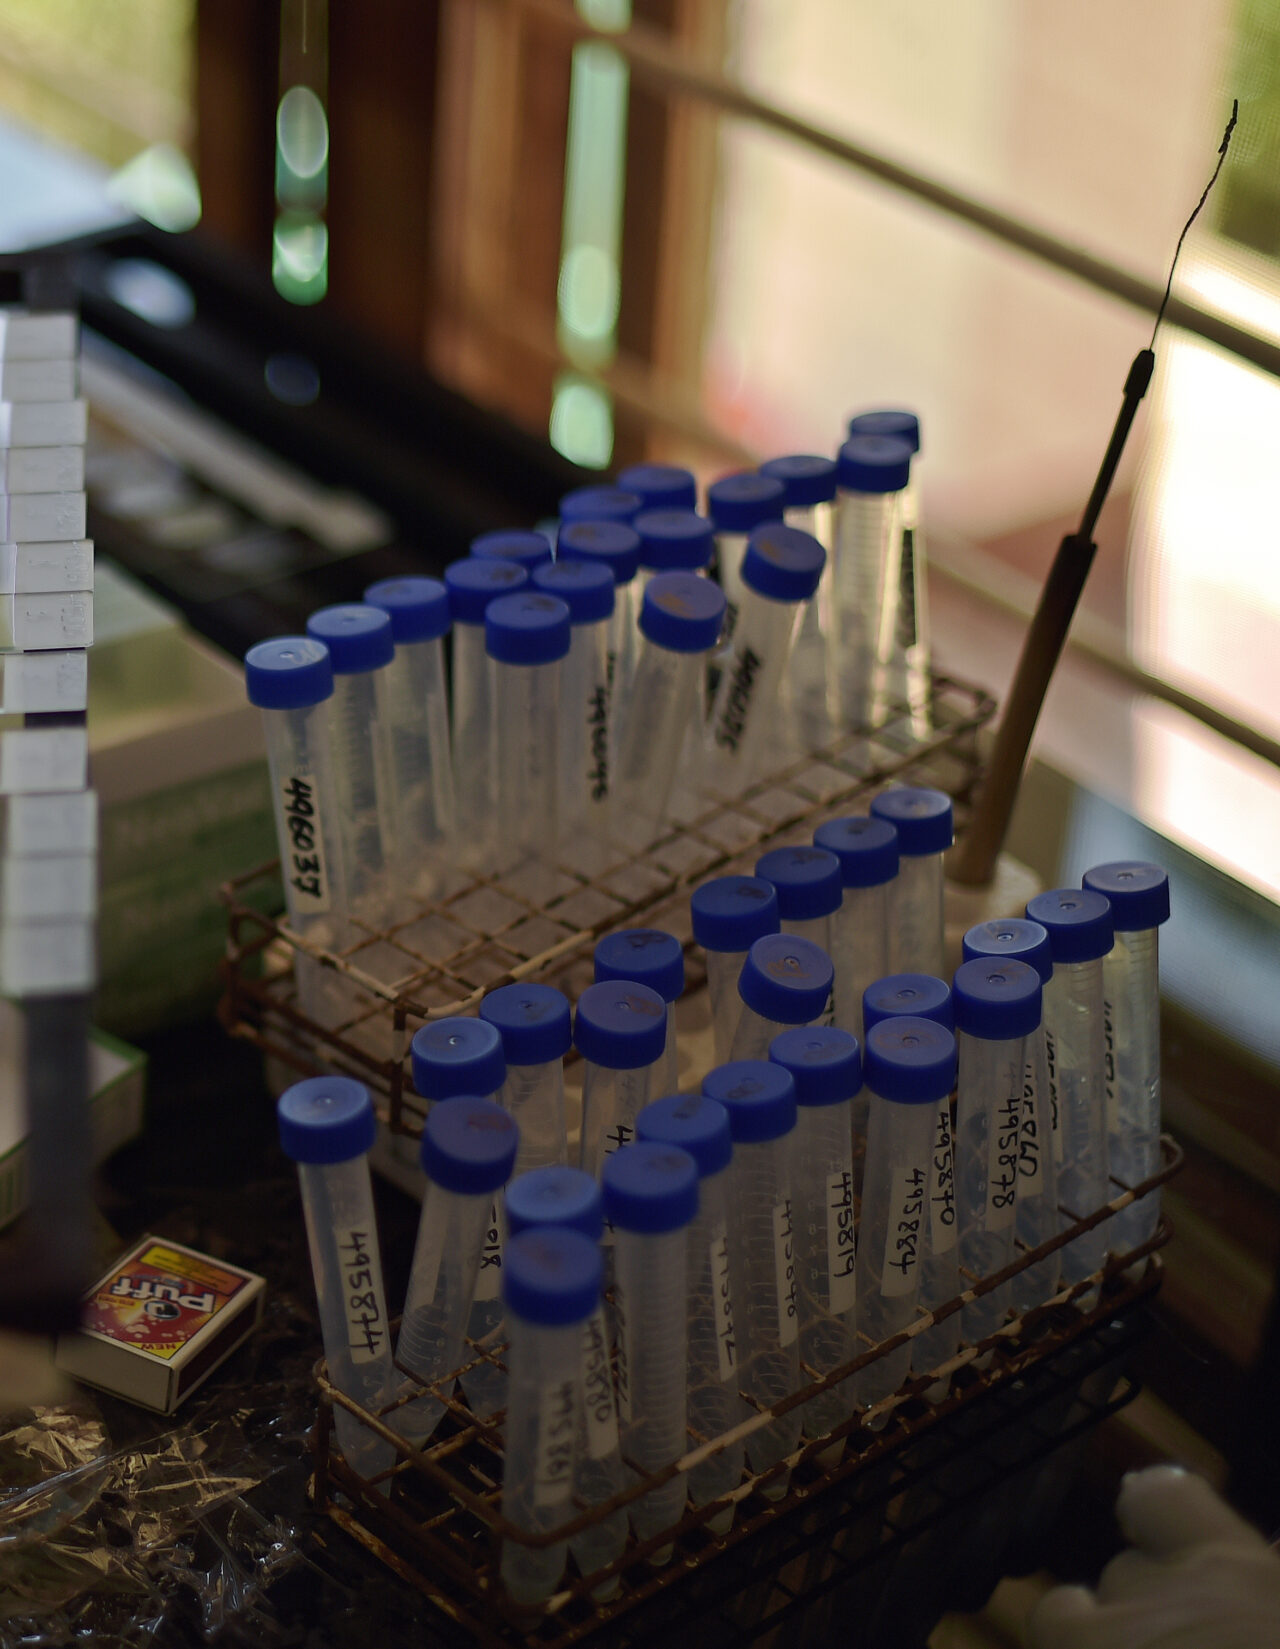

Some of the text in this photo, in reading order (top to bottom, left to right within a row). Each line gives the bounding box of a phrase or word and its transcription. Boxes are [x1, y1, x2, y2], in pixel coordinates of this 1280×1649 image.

[284, 777, 323, 900] 496037
[931, 1111, 955, 1226] 495870
[991, 1097, 1021, 1209] 495878
[831, 1171, 854, 1278] 495819
[111, 1275, 217, 1313] Puff
[140, 1342, 177, 1351] NEW
[338, 1230, 384, 1354] 495874
